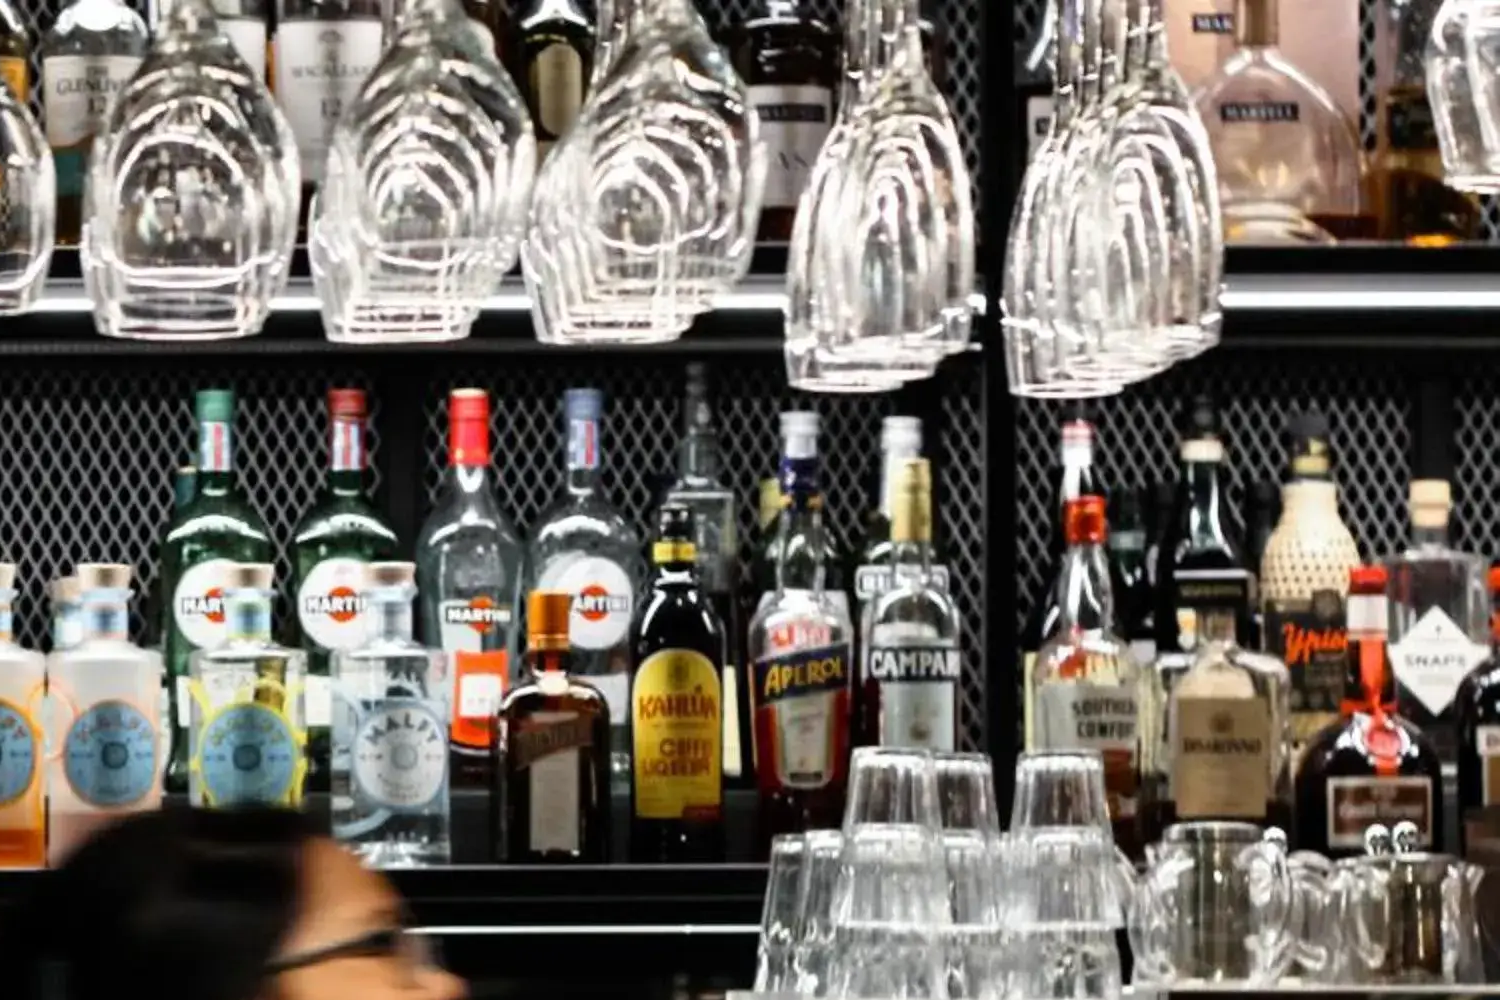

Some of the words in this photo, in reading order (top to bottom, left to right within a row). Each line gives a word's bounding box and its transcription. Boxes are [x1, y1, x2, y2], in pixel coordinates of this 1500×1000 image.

[56, 78, 126, 95] GLENLIV
[181, 599, 227, 615] MART
[304, 599, 366, 614] MARTI
[574, 595, 629, 611] ARTINI
[870, 649, 961, 677] CAMPAR
[1404, 654, 1467, 668] SNAPS
[764, 655, 845, 697] APEROL
[364, 712, 439, 744] MALFY
